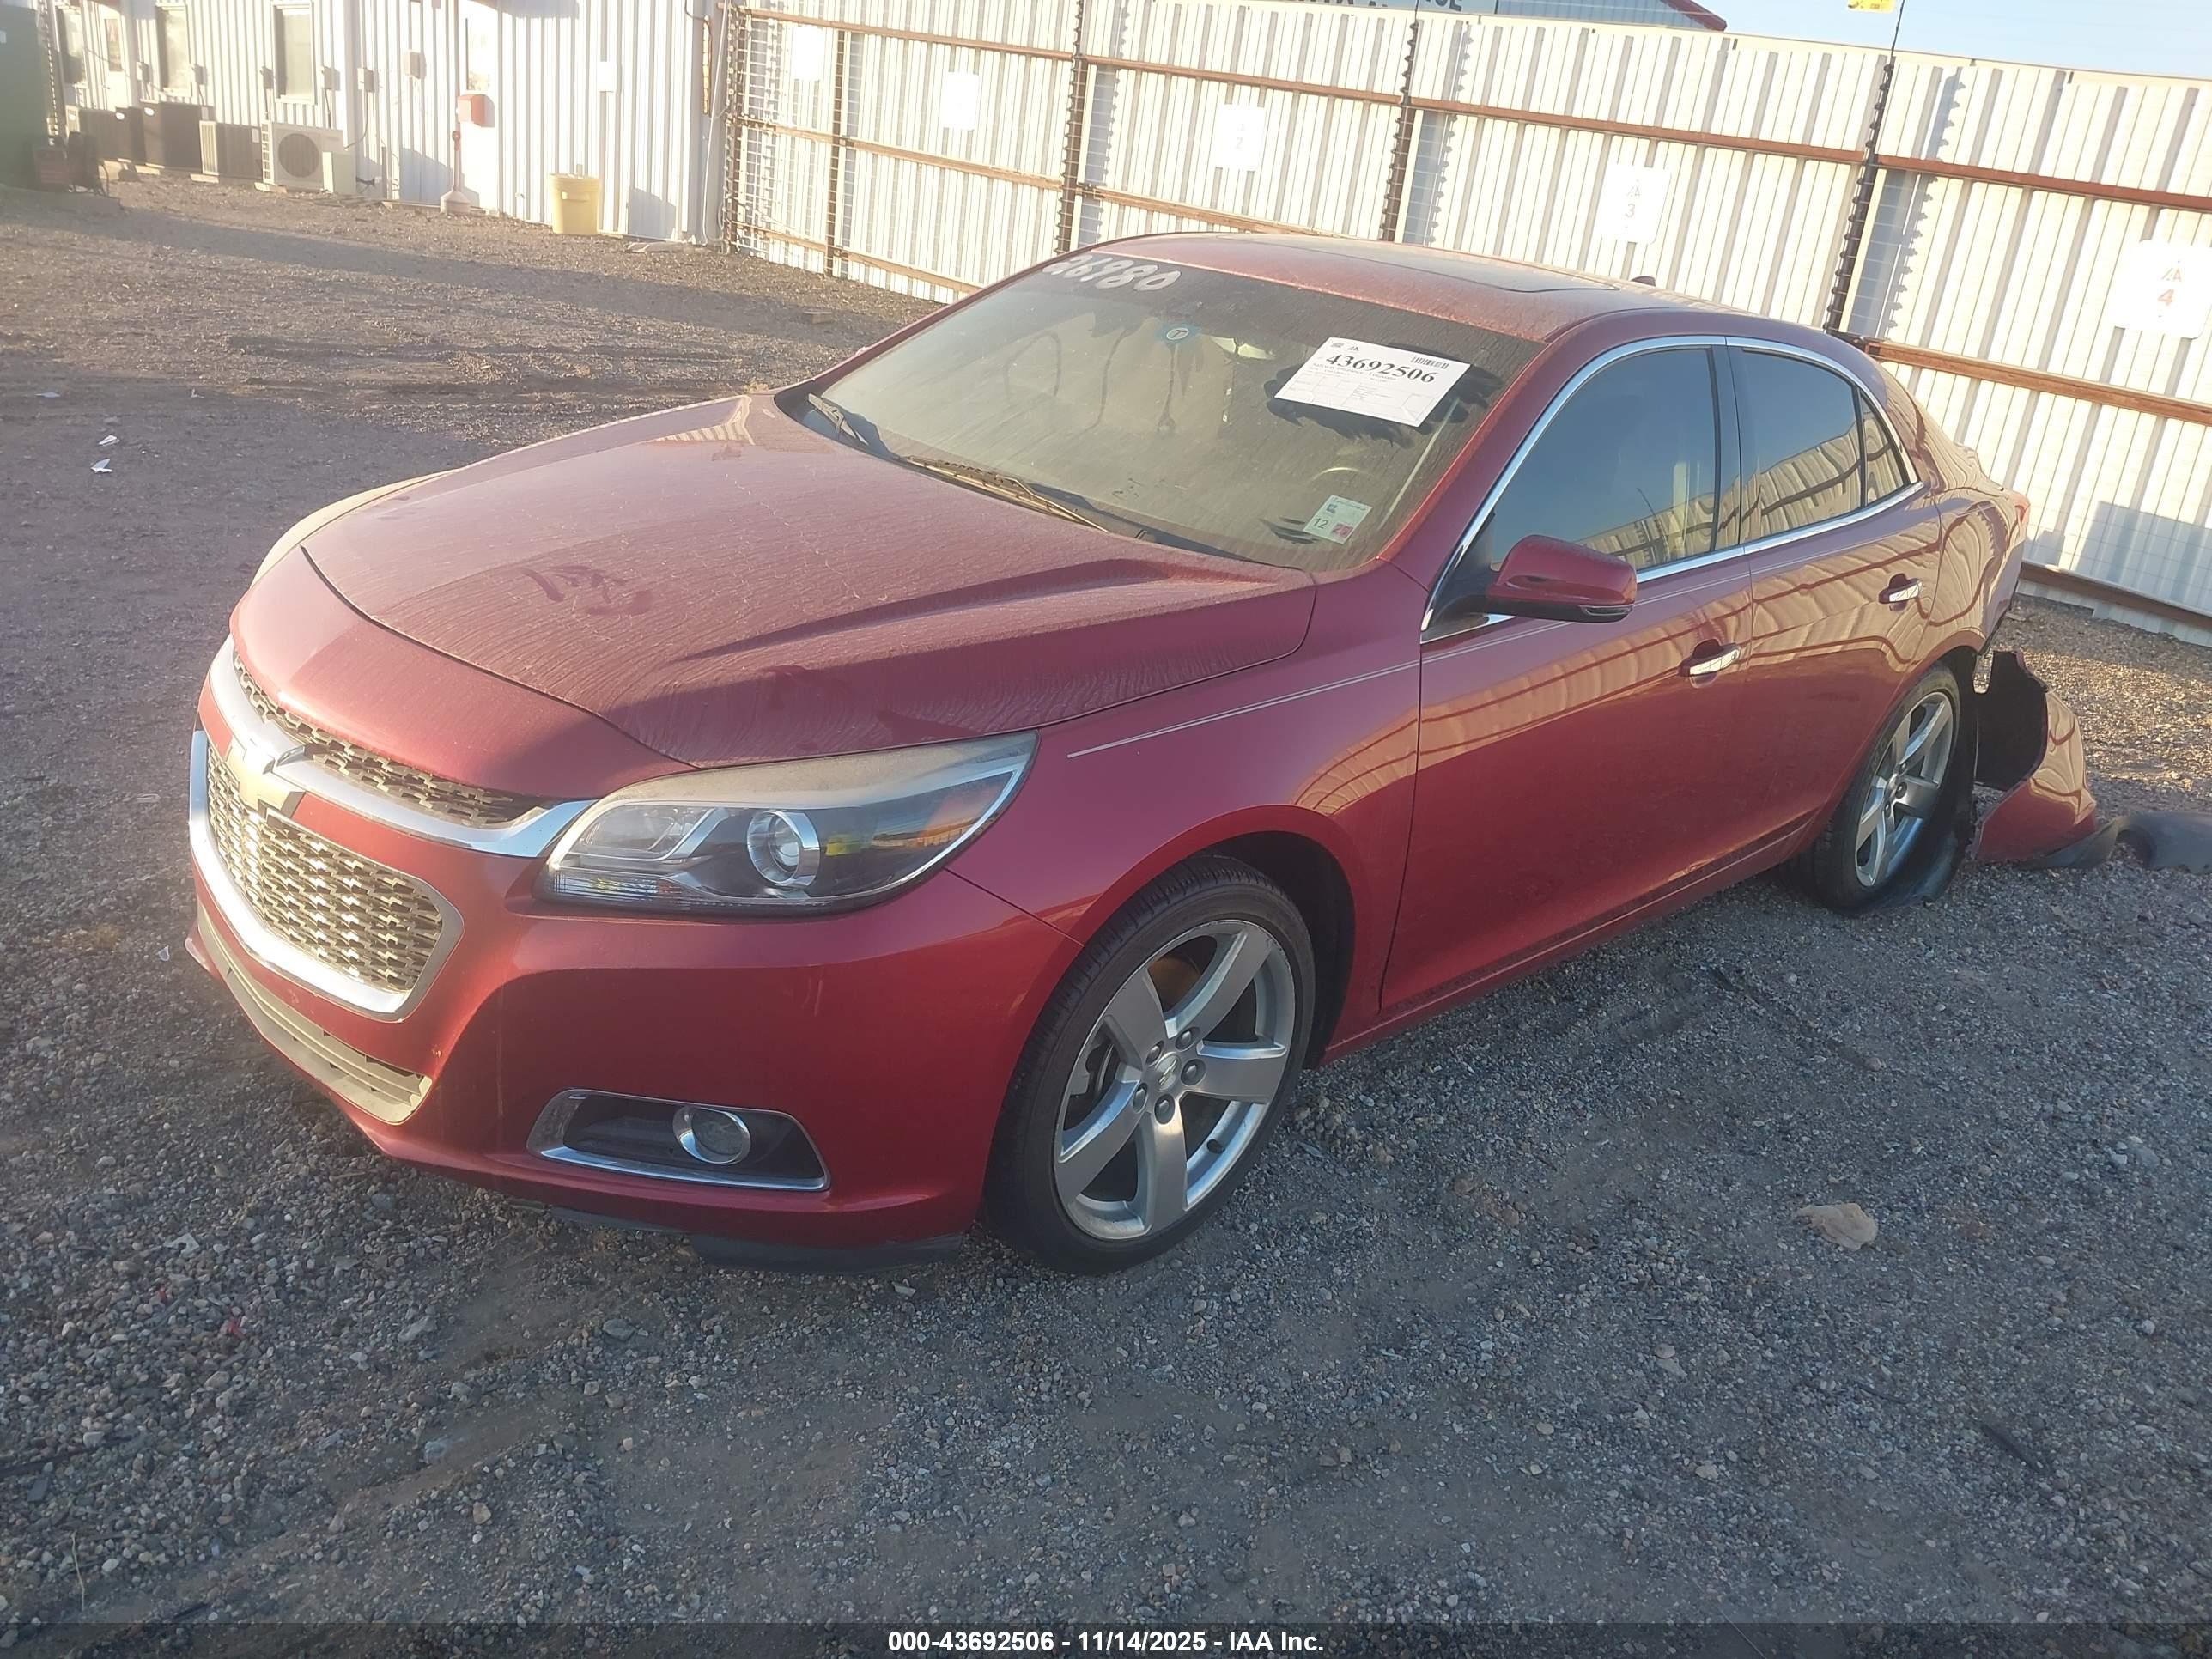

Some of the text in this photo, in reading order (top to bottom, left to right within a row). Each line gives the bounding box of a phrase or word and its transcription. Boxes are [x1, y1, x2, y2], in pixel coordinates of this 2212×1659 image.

[1624, 203, 1636, 218] 3
[2156, 288, 2175, 307] 4
[1325, 354, 1439, 383] 43692506
[1312, 517, 1329, 529] 12
